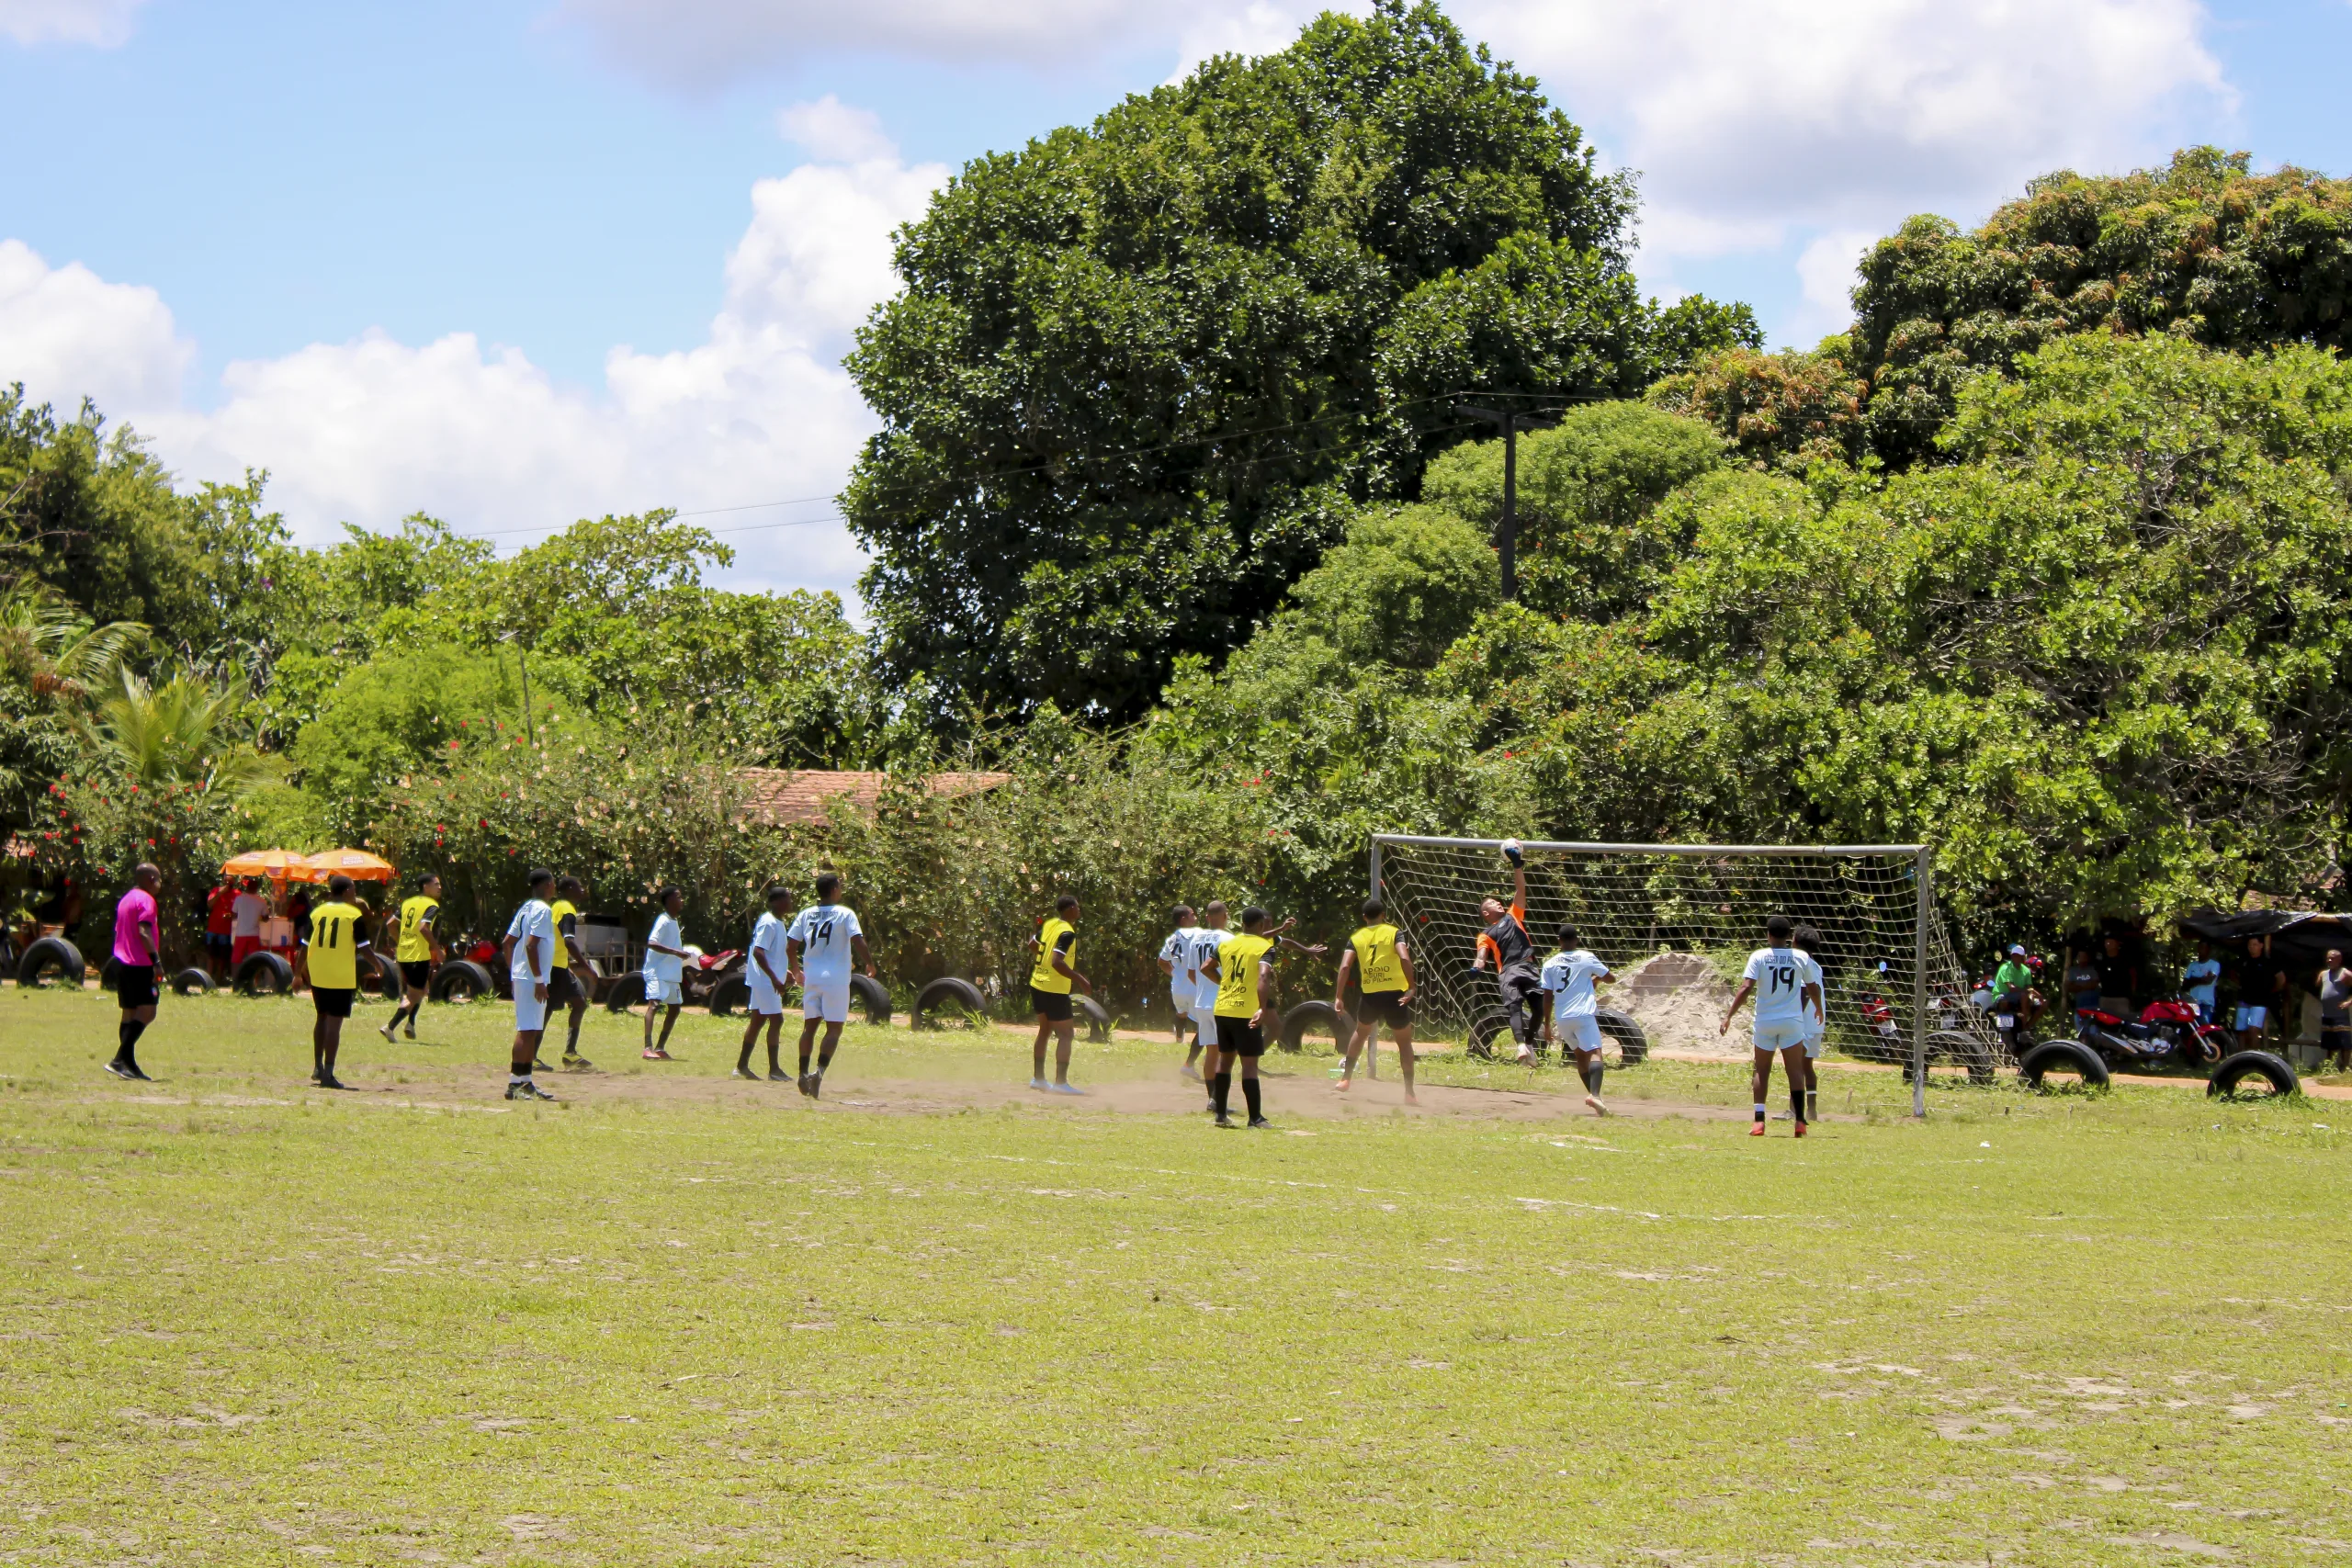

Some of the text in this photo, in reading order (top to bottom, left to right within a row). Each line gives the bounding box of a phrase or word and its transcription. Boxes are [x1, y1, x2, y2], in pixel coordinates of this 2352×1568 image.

[405, 907, 416, 929] 9
[318, 917, 340, 949] 11
[1369, 943, 1377, 965] 7
[1230, 954, 1245, 983] 14
[1363, 965, 1390, 975] APOIO
[1555, 965, 1571, 993] 3
[1768, 966, 1795, 994] 19
